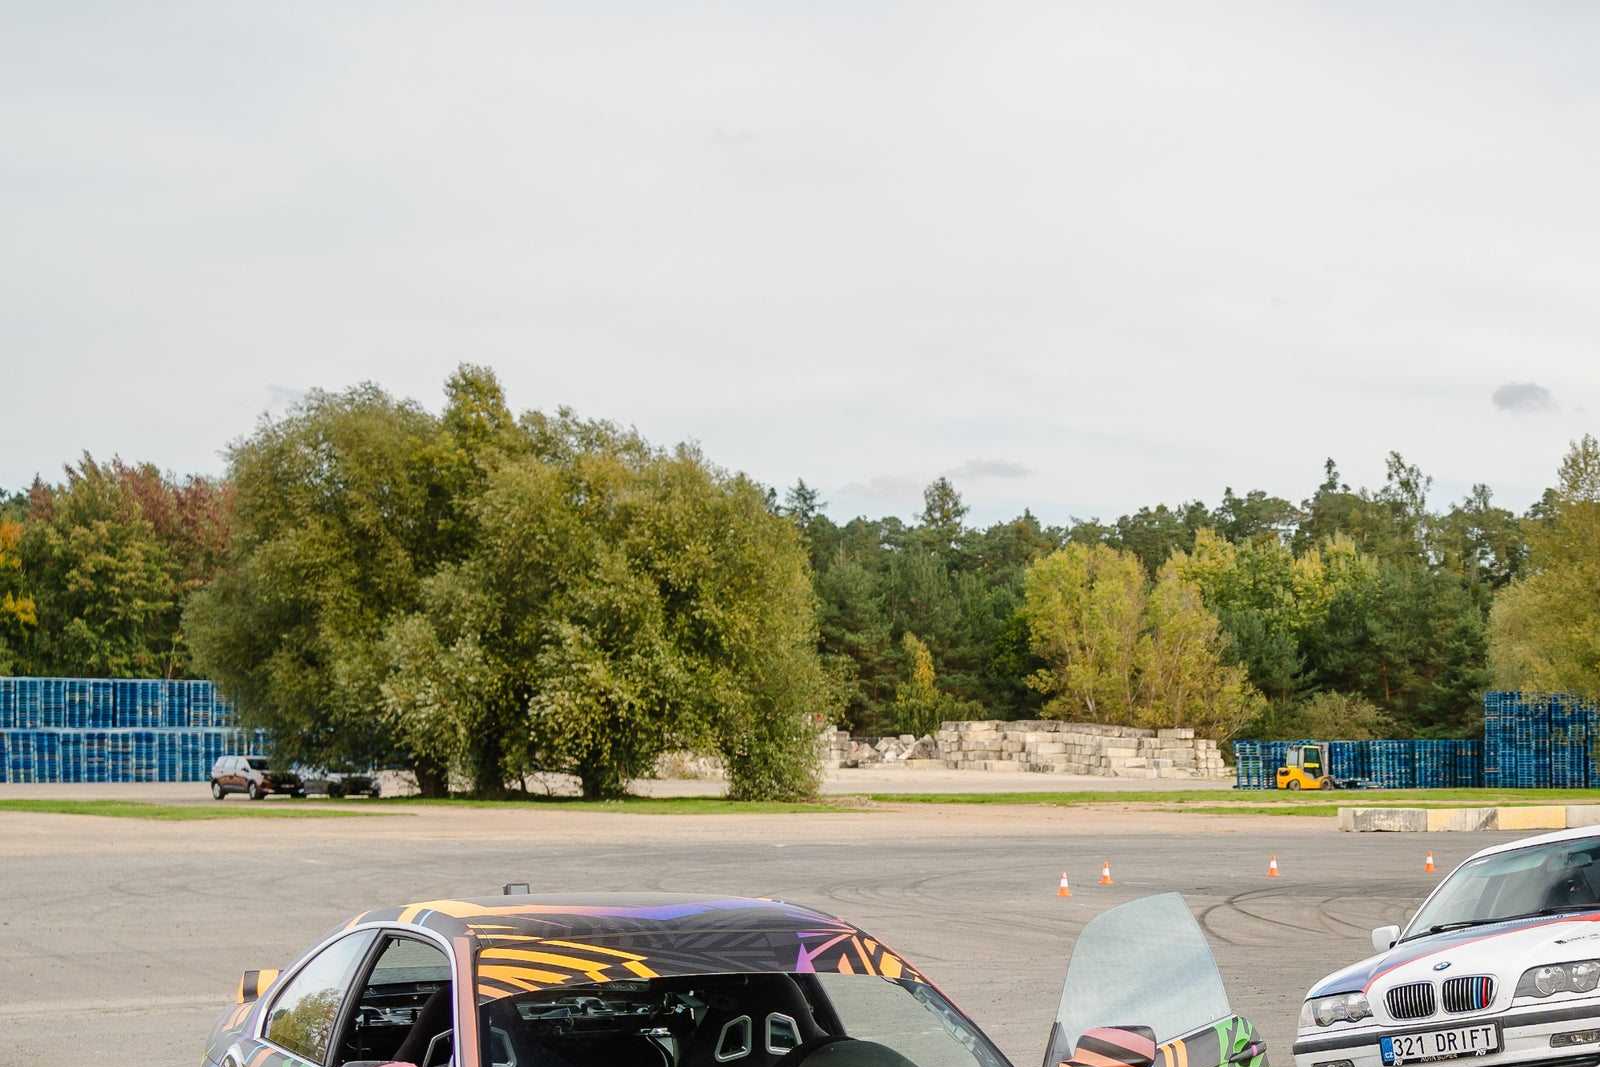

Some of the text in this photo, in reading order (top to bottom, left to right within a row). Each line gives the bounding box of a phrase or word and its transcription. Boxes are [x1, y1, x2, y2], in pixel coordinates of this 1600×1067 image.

[1384, 1027, 1491, 1059] CZ 321 DRIFT
